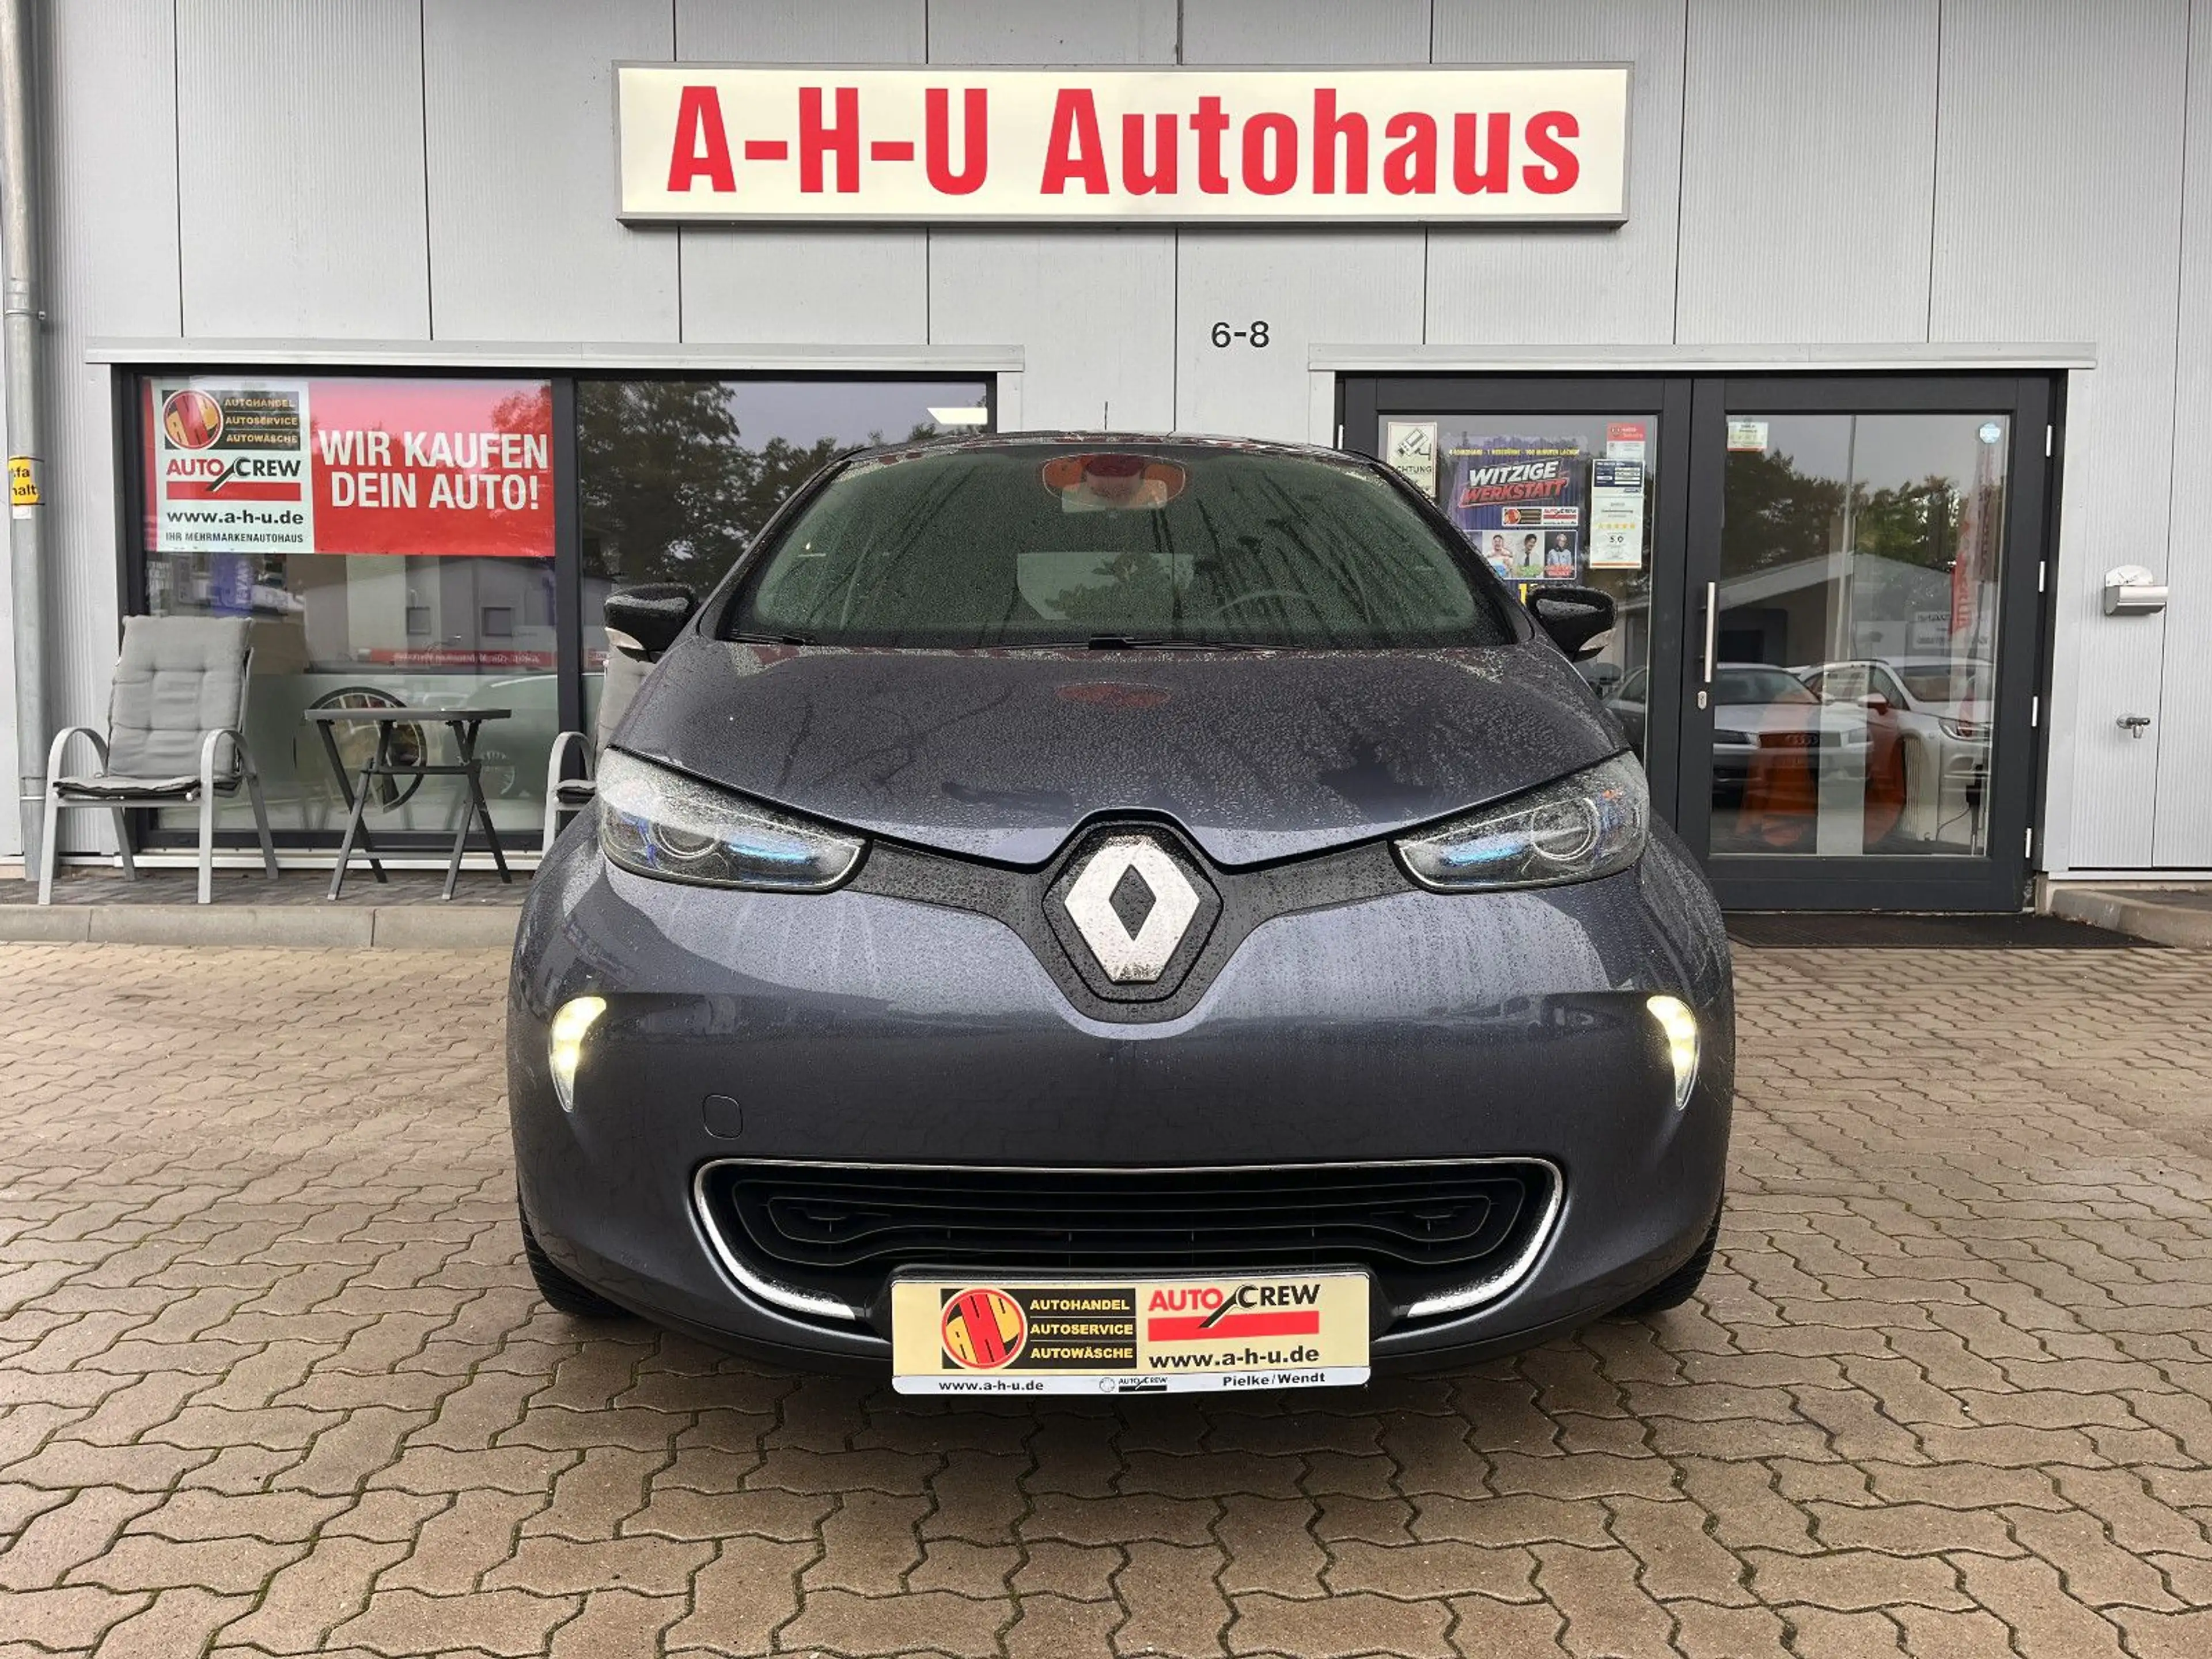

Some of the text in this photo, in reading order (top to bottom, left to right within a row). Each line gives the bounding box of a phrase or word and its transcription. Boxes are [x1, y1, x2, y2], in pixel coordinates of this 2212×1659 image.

[667, 86, 1579, 195] A-H-U Autohaus
[1211, 321, 1269, 347] 6-8
[225, 399, 296, 407] AUTOHANDEL
[225, 416, 298, 425] AUTOSERVICE
[318, 430, 548, 469] WIR KAUFEN
[166, 458, 301, 477] AUTO CREW
[1469, 461, 1559, 486] WITZIGE
[331, 471, 539, 510] DEIN AUTO!
[1463, 478, 1566, 502] WERKSTATT
[167, 510, 304, 525] www.a-h-u.de
[166, 532, 304, 543] IHR MEHRMARKENAUTOHAUS
[1030, 1299, 1130, 1310] AUTOHANDEL
[1148, 1284, 1320, 1312] AUTO CREW
[1030, 1324, 1134, 1335] AUTOSERVICE
[1030, 1346, 1134, 1359] AUTOWÄSCHE
[1149, 1345, 1320, 1368] www.a-h-u.de
[939, 1380, 1044, 1391] www.a-h-u.de
[1222, 1372, 1325, 1387] Pielke/Wendt
